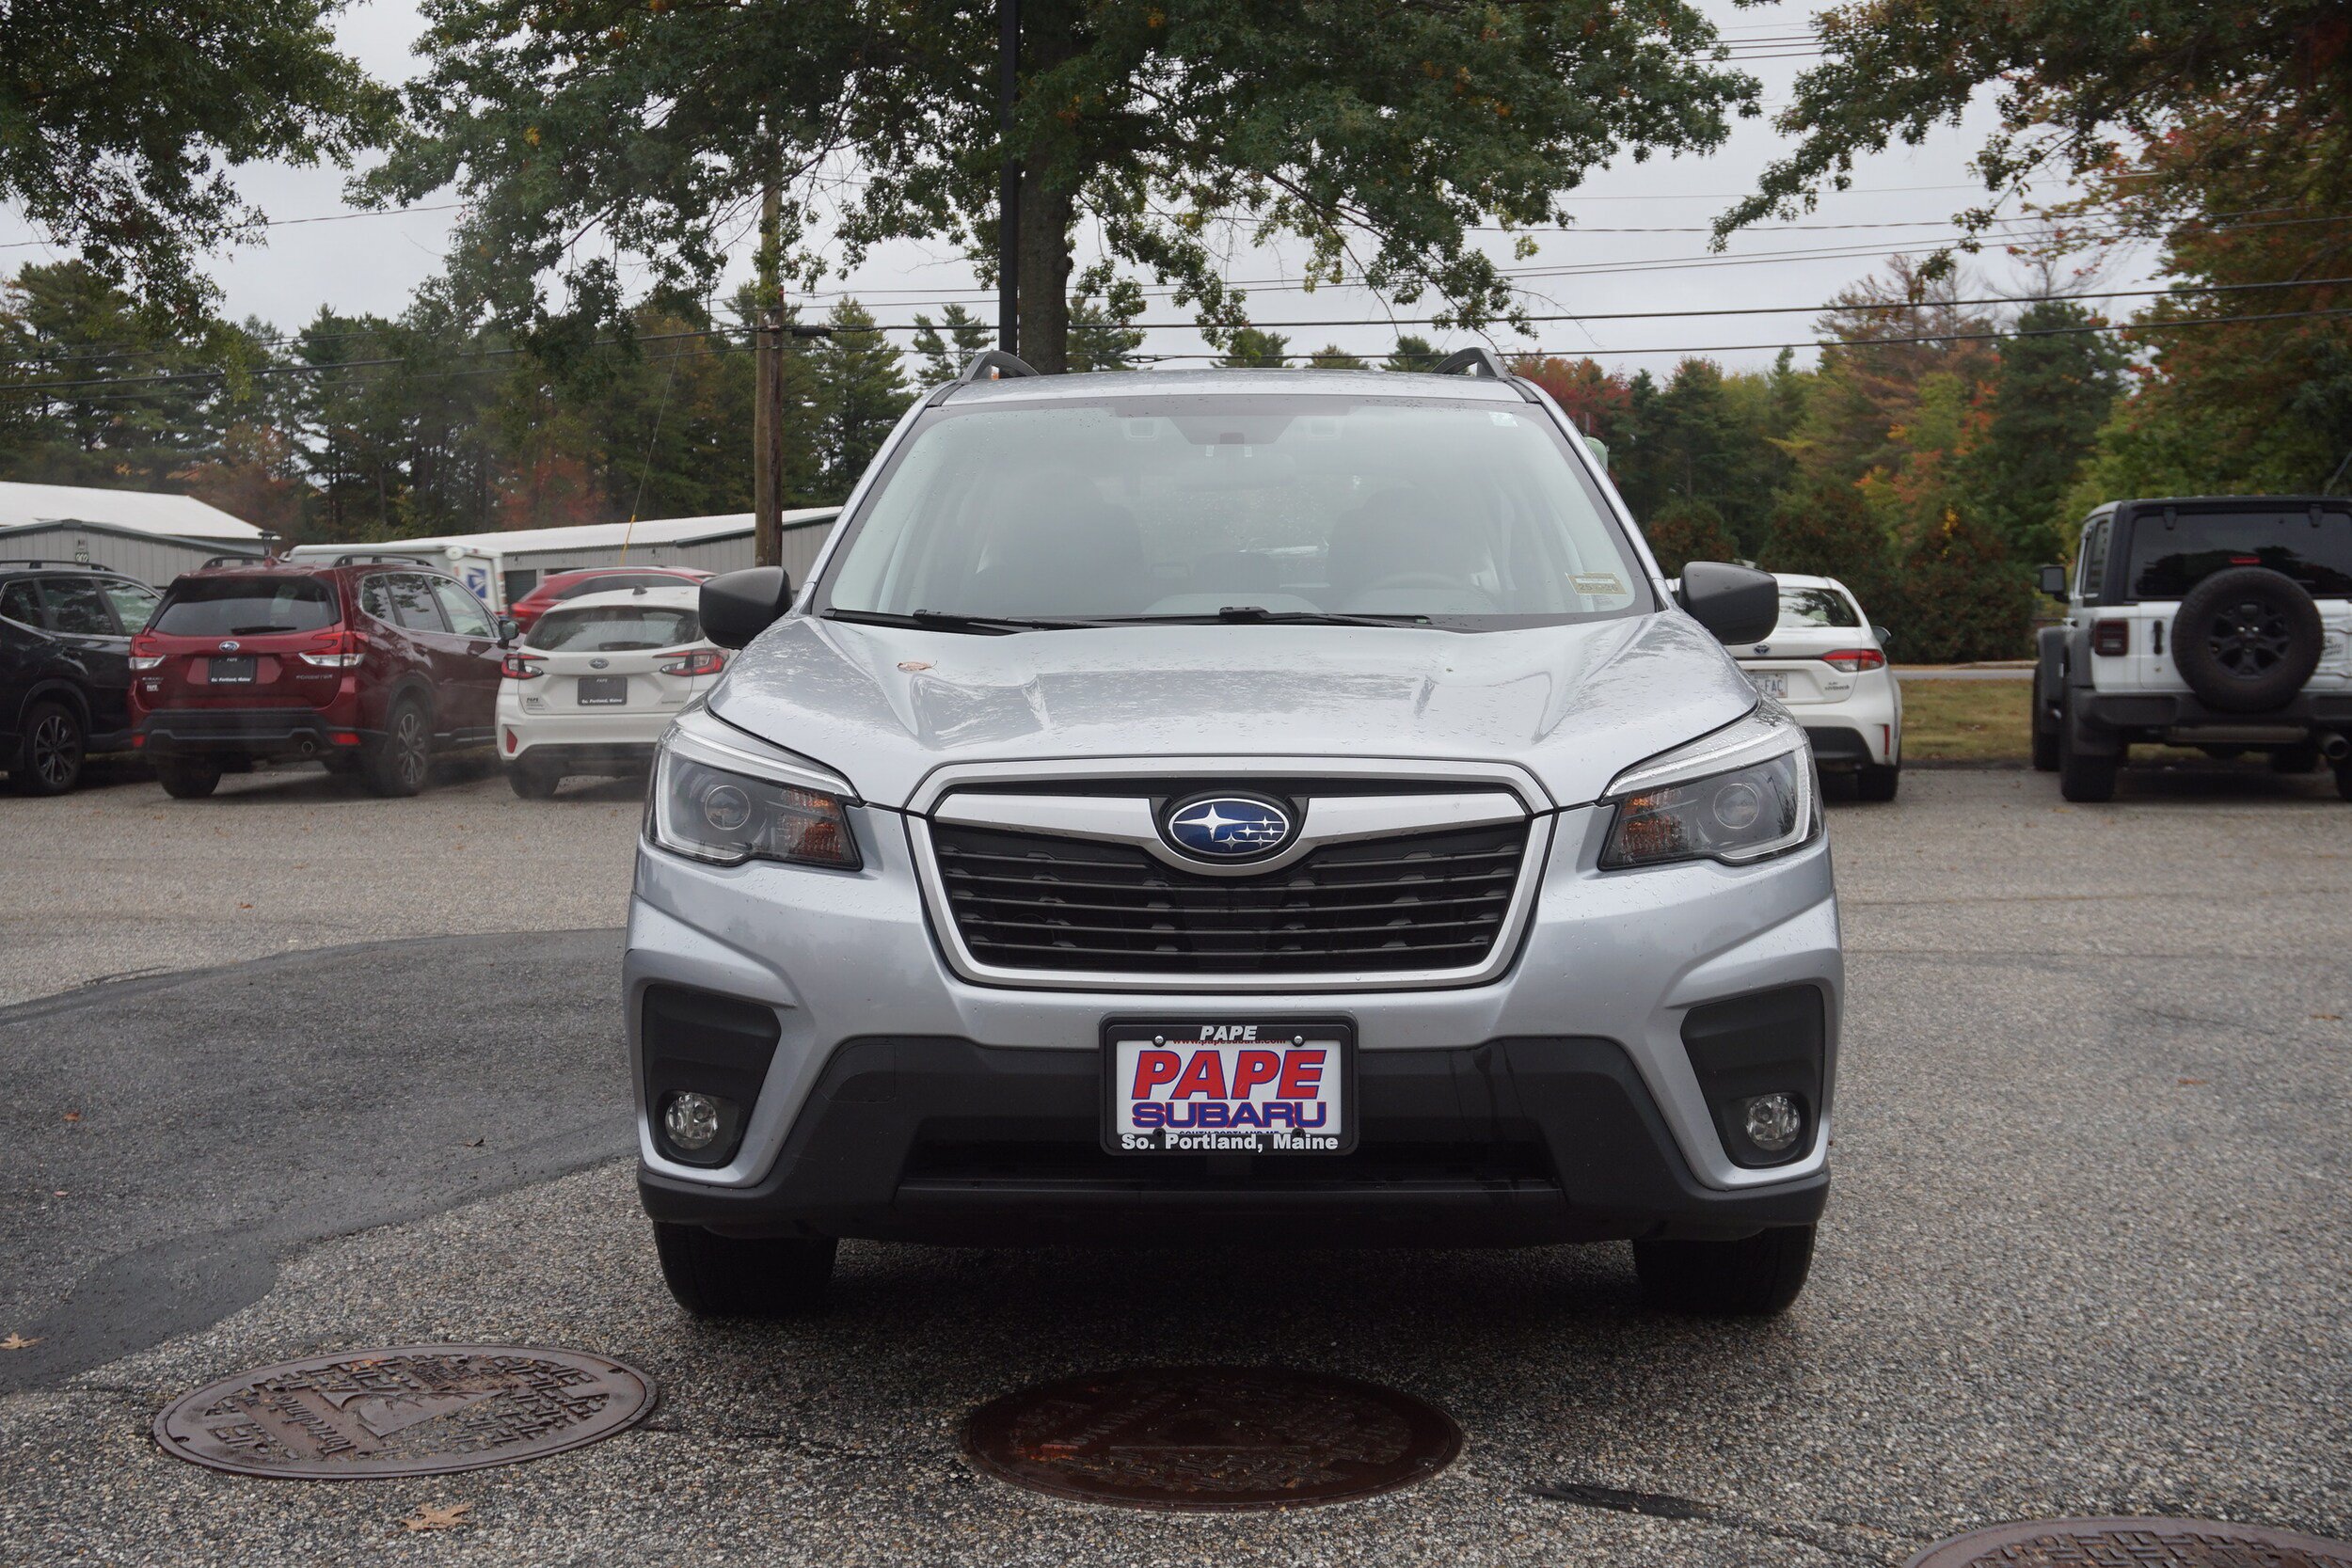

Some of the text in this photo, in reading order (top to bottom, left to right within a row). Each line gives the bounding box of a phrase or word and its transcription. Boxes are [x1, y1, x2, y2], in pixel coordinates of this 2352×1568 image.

[1200, 1025, 1257, 1041] PAPE
[1131, 1050, 1327, 1100] PAPE
[1132, 1101, 1327, 1128] SUBARU
[1121, 1133, 1339, 1153] So. Portland, Maine
